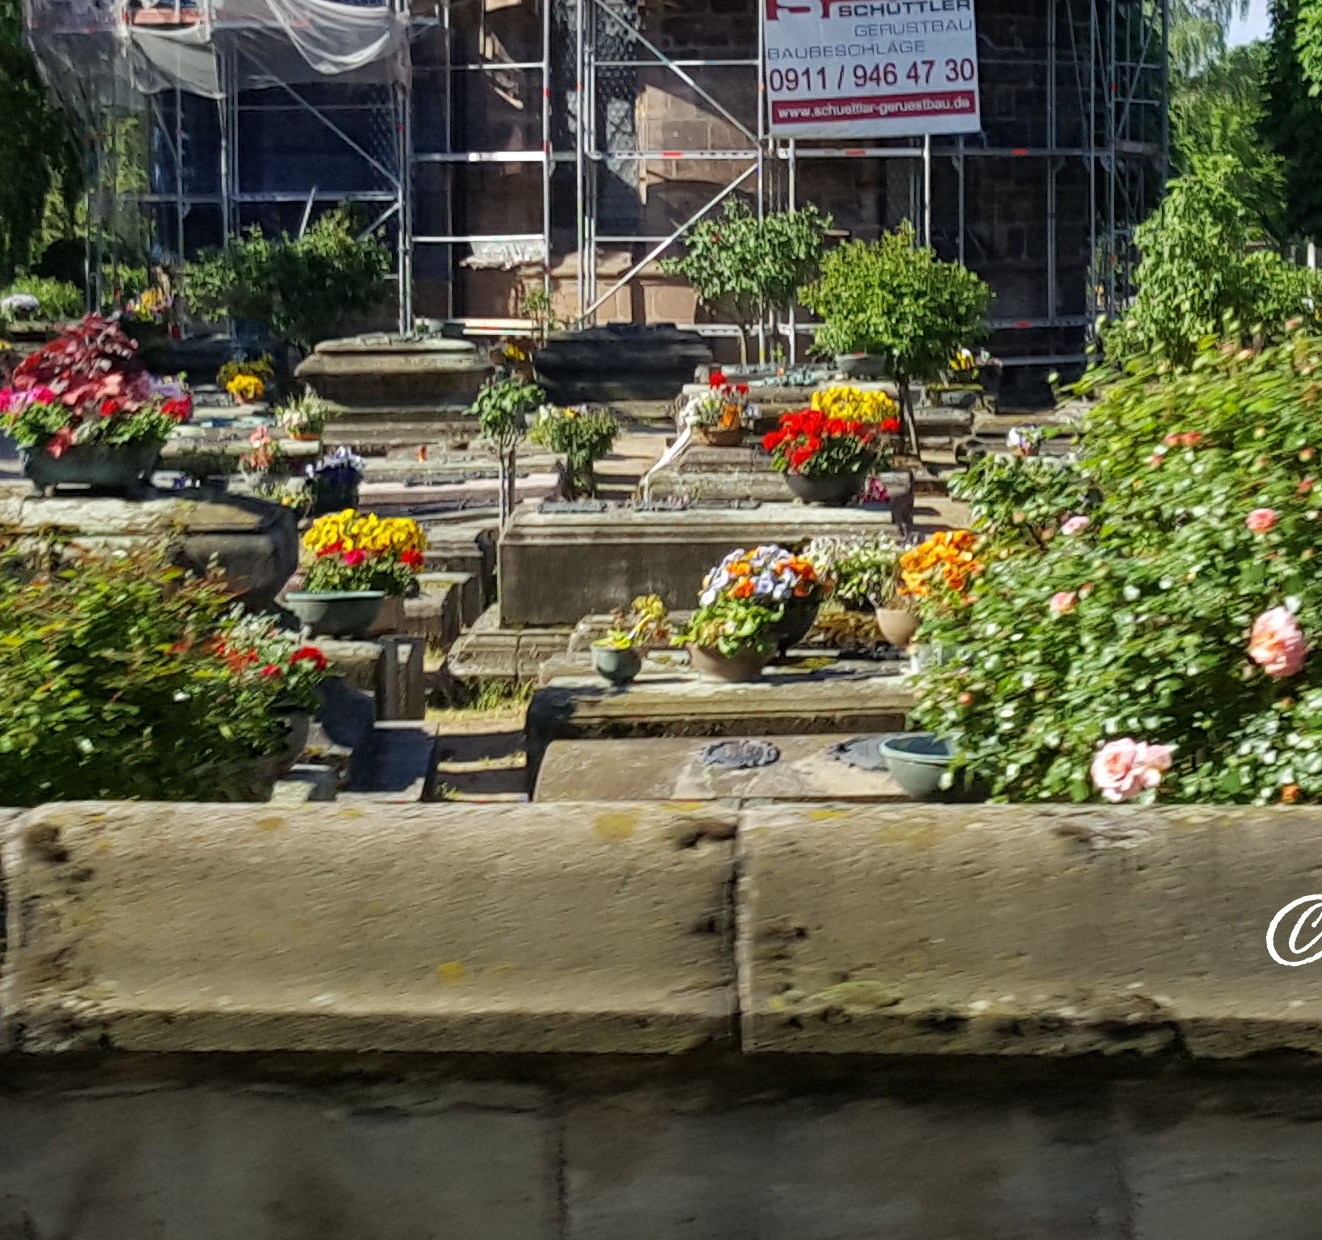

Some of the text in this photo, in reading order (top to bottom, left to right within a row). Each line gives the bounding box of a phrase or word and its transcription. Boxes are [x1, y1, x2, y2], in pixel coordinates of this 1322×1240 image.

[769, 58, 975, 92] 0911 / 946 47 30
